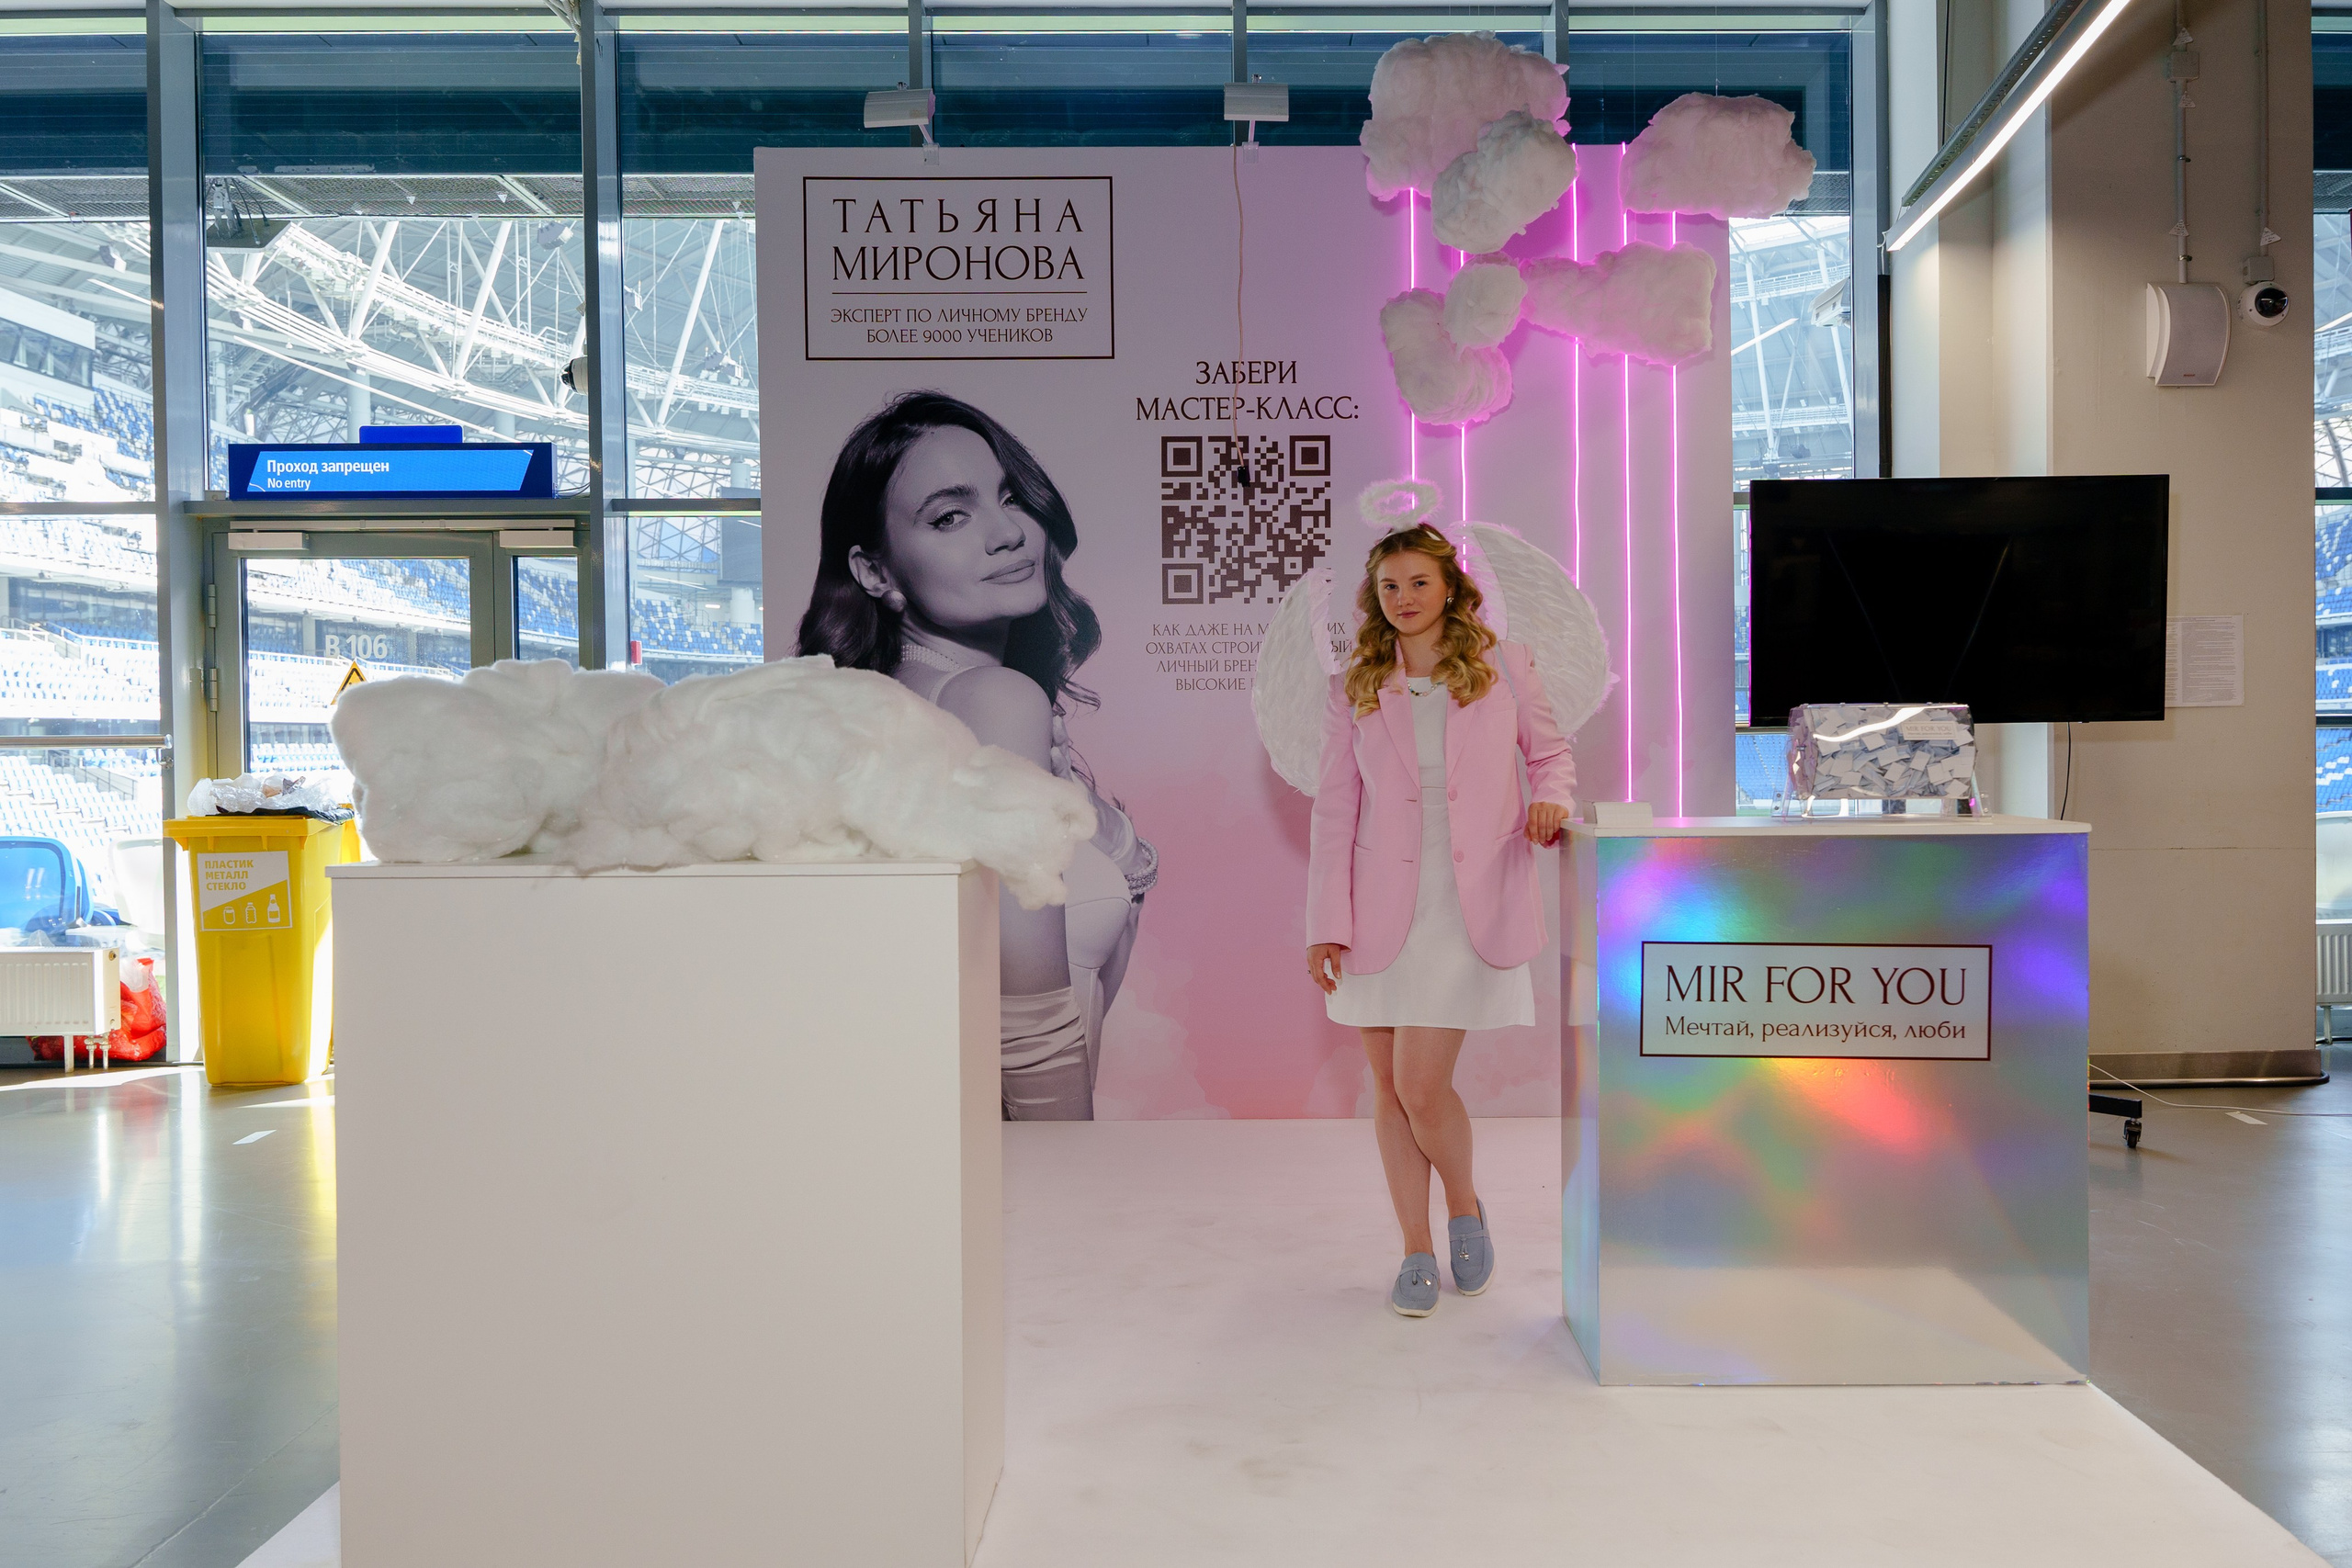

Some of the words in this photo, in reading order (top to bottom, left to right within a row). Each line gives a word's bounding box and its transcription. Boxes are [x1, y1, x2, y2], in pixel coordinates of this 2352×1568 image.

[832, 198, 1084, 233] ТАТЬЯНА
[832, 245, 1085, 281] МИРОНОВА
[831, 309, 901, 323] ЭКСПЕРТ
[906, 309, 932, 322] ПО
[937, 308, 1021, 322] ЛИЧНОМУ
[1026, 308, 1088, 322] БРЕНДУ
[866, 329, 919, 344] БОЛЕЕ
[922, 329, 963, 343] 9000
[967, 328, 1054, 344] УЧЕНИКОВ
[1195, 360, 1297, 385] ЗАБЕРИ
[1136, 396, 1359, 421] МАСТЕР-КЛАСС:
[266, 459, 319, 475] Проход
[322, 461, 390, 476] запрещен
[266, 478, 283, 489] No
[284, 479, 311, 491] entry
[1152, 623, 1181, 637] КАК
[1185, 623, 1229, 637] ДАЖЕ
[1233, 623, 1253, 636] НА
[345, 634, 388, 660] 106
[1145, 641, 1207, 655] ОХВАТАХ
[1211, 641, 1262, 654] СТРОИ
[1156, 658, 1219, 672] ЛИЧНЫЙ
[1224, 659, 1258, 672] БРЕН
[1175, 678, 1246, 691] ВЫСОКИЕ
[204, 859, 254, 869] ПЛАСТИК
[205, 870, 249, 880] МЕТАЛЛ
[206, 882, 247, 891] СТЕКЛО
[1665, 964, 1748, 1003] MIR
[1764, 965, 1857, 1005] FOR
[1871, 966, 1967, 1006] YOU
[1665, 1015, 1755, 1039] Мечтай,
[1761, 1020, 1897, 1043] реализуйся,
[1903, 1020, 1966, 1039] люби
